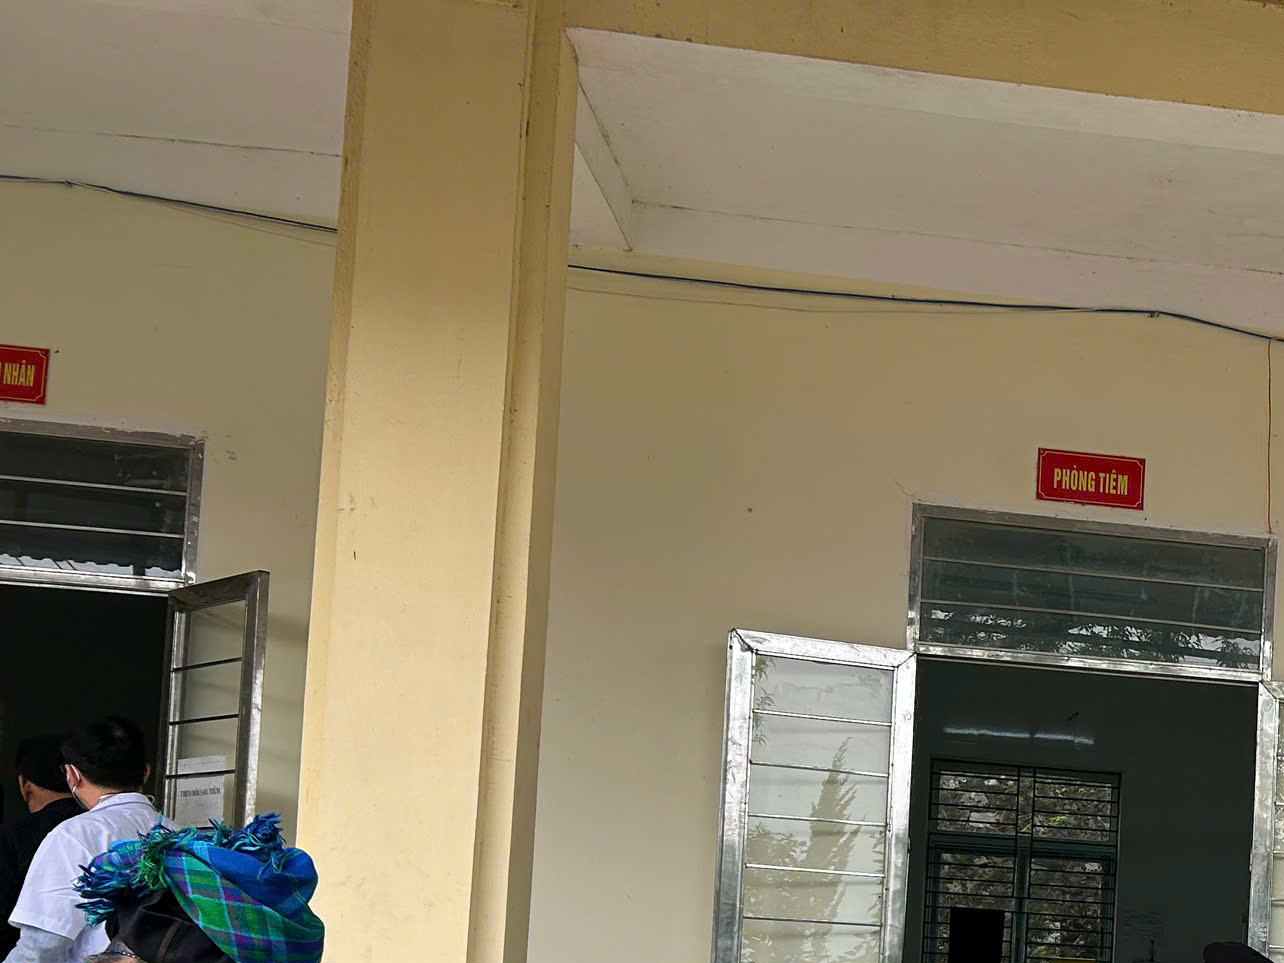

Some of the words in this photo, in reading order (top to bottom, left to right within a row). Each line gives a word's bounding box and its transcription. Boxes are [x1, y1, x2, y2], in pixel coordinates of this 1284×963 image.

[3, 360, 35, 387] NHÂN
[1053, 464, 1096, 492] PHÒNG
[1099, 469, 1128, 495] TIÊM
